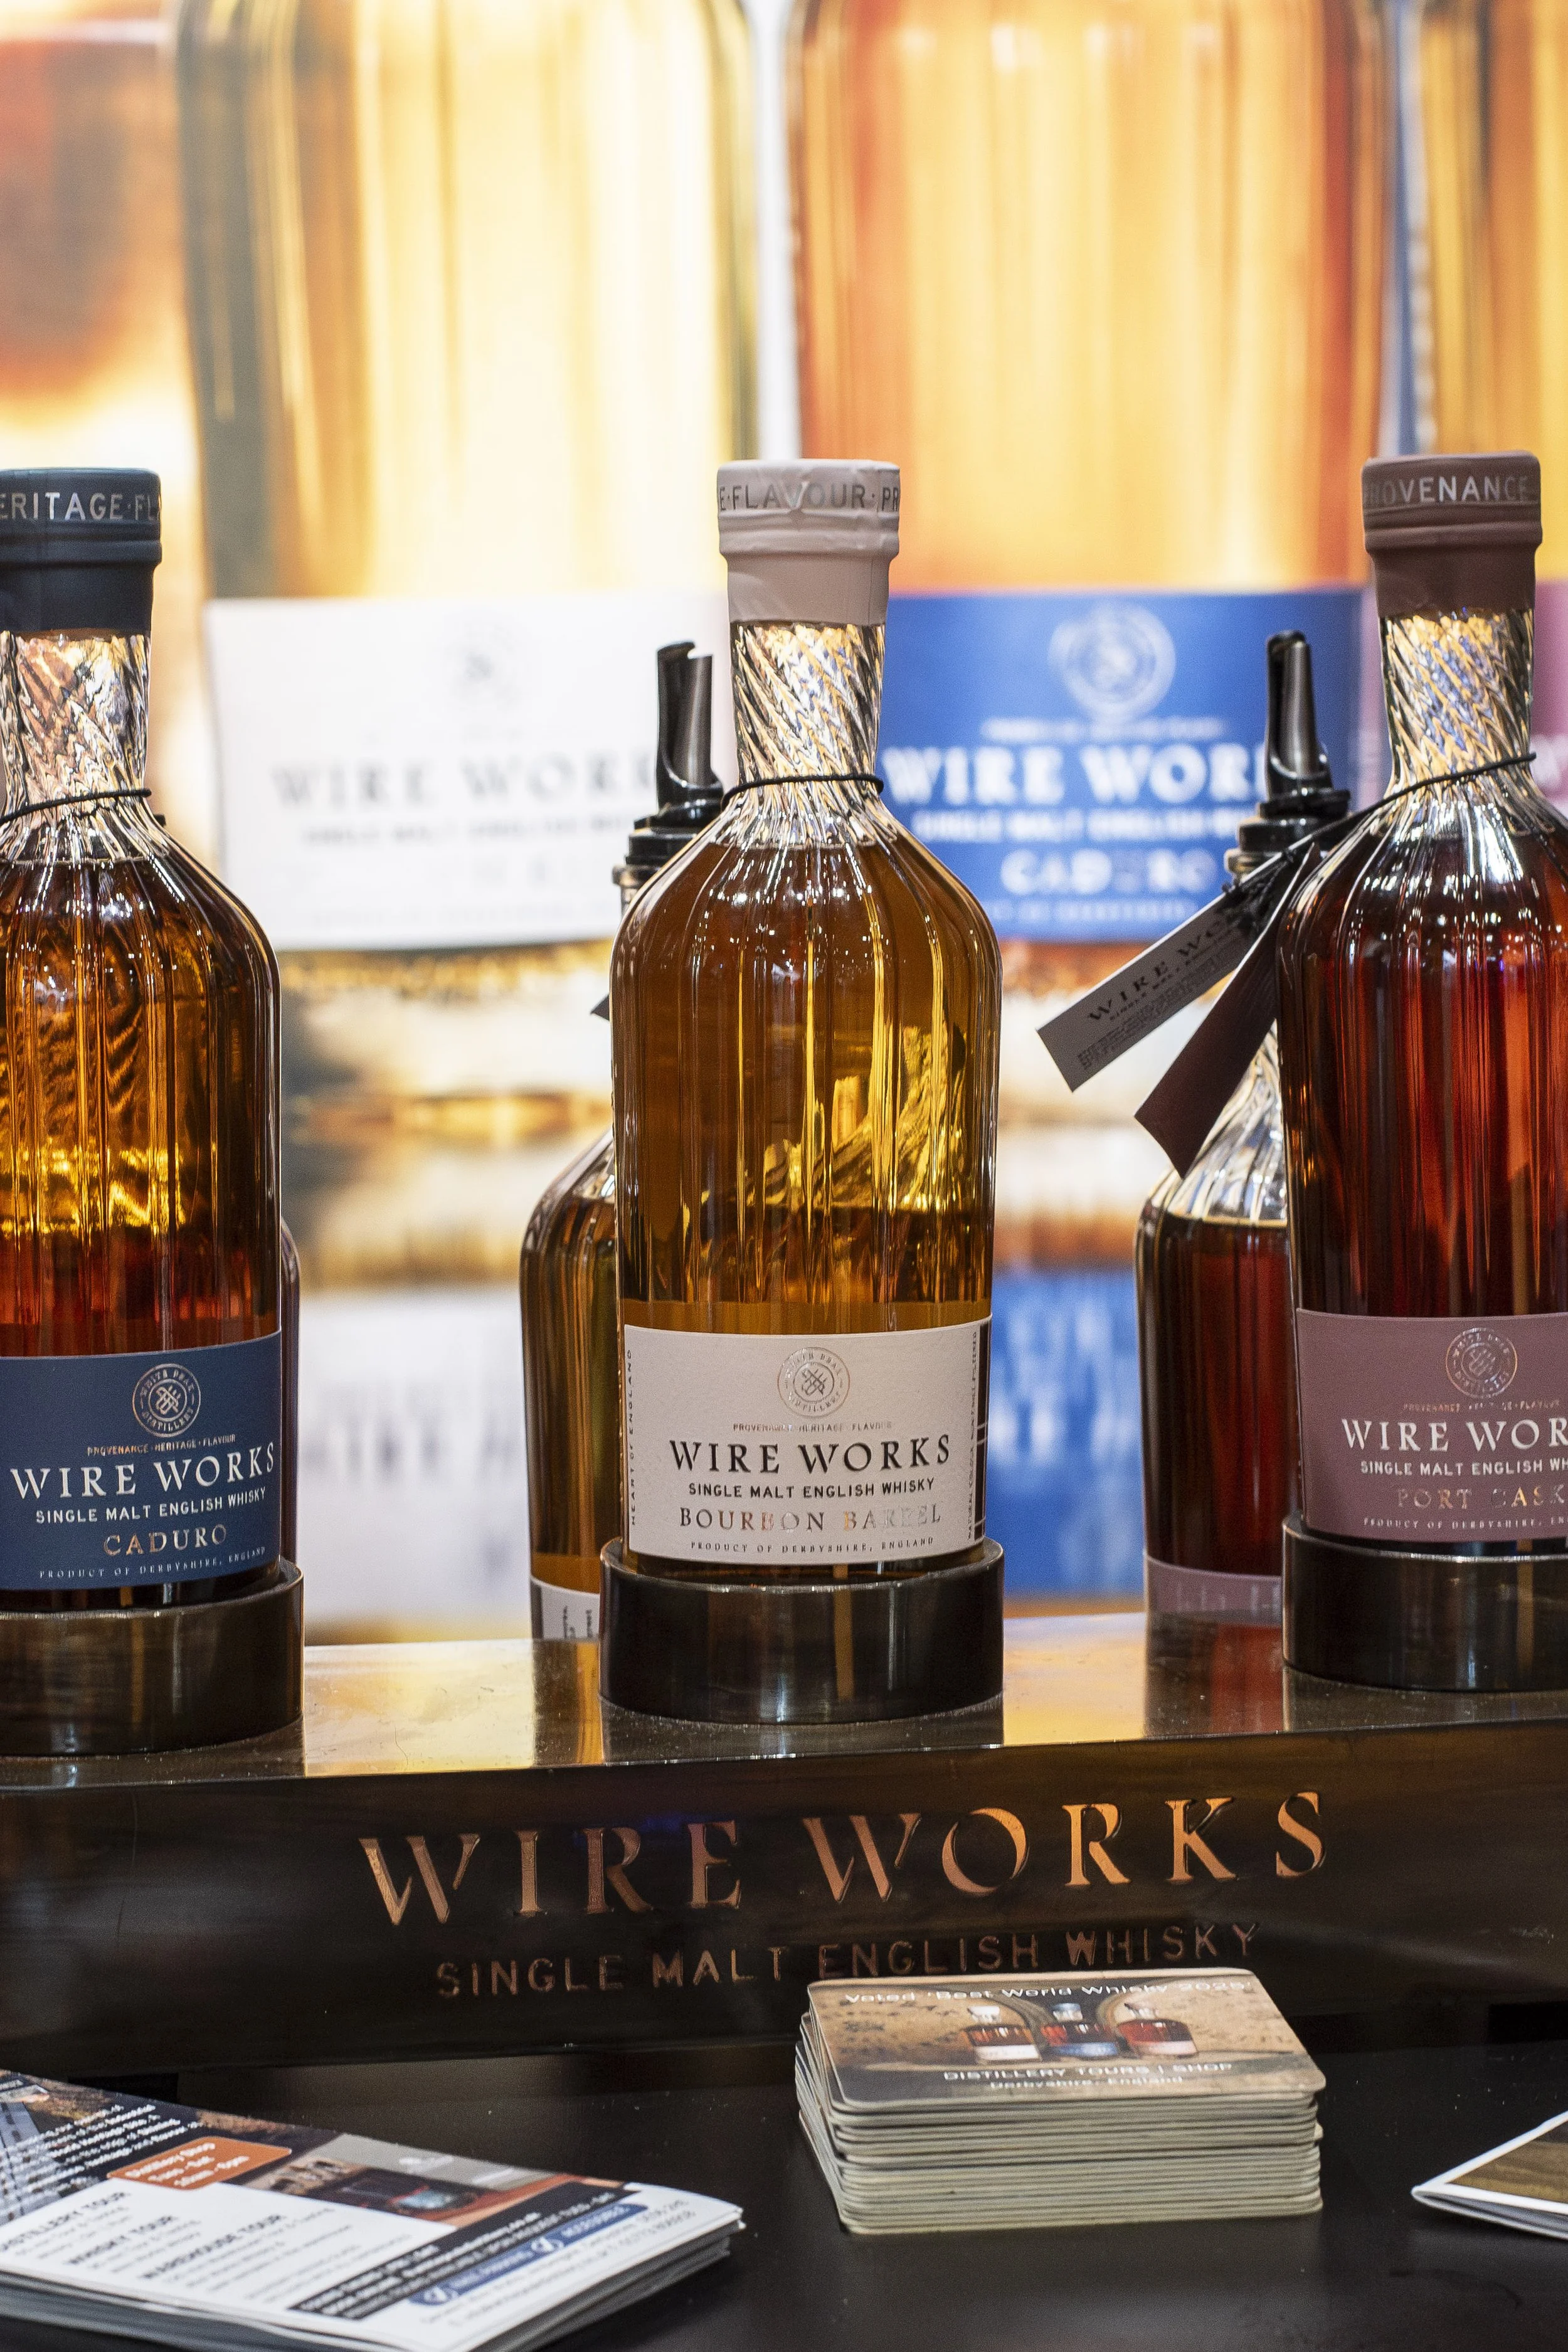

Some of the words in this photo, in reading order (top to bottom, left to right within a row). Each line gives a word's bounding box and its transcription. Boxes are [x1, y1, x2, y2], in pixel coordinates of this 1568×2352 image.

[881, 746, 1066, 805] WIRE
[1341, 1417, 1449, 1452] WIRE
[10, 1463, 136, 1500] WIRE
[154, 1442, 274, 1493] WORKS
[669, 1439, 780, 1475] WIRE
[797, 1433, 950, 1475] WORKS
[1360, 1460, 1412, 1475] SINGLE
[1419, 1462, 1465, 1476] MALT
[1471, 1459, 1544, 1475] ENGLISH
[689, 1482, 742, 1498] SINGLE
[750, 1485, 795, 1498] MALT
[803, 1483, 874, 1498] ENGLISH
[882, 1476, 935, 1495] WHISKY
[1397, 1487, 1473, 1510] PORT
[36, 1508, 98, 1525] SINGLE
[105, 1505, 151, 1522] MALT
[159, 1496, 223, 1517] ENGLISH
[228, 1486, 266, 1508] WHISKY
[680, 1507, 824, 1532] BOURBON
[103, 1524, 227, 1557] CADURO
[358, 1820, 741, 1926] WIRE
[800, 1791, 1328, 1904] WORKS
[437, 1954, 625, 1998] SINGLE
[652, 1946, 788, 1988] MALT
[818, 1933, 1039, 1979] ENGLISH
[1066, 1922, 1260, 1967] WHISKY
[1002, 1986, 1072, 1998] World
